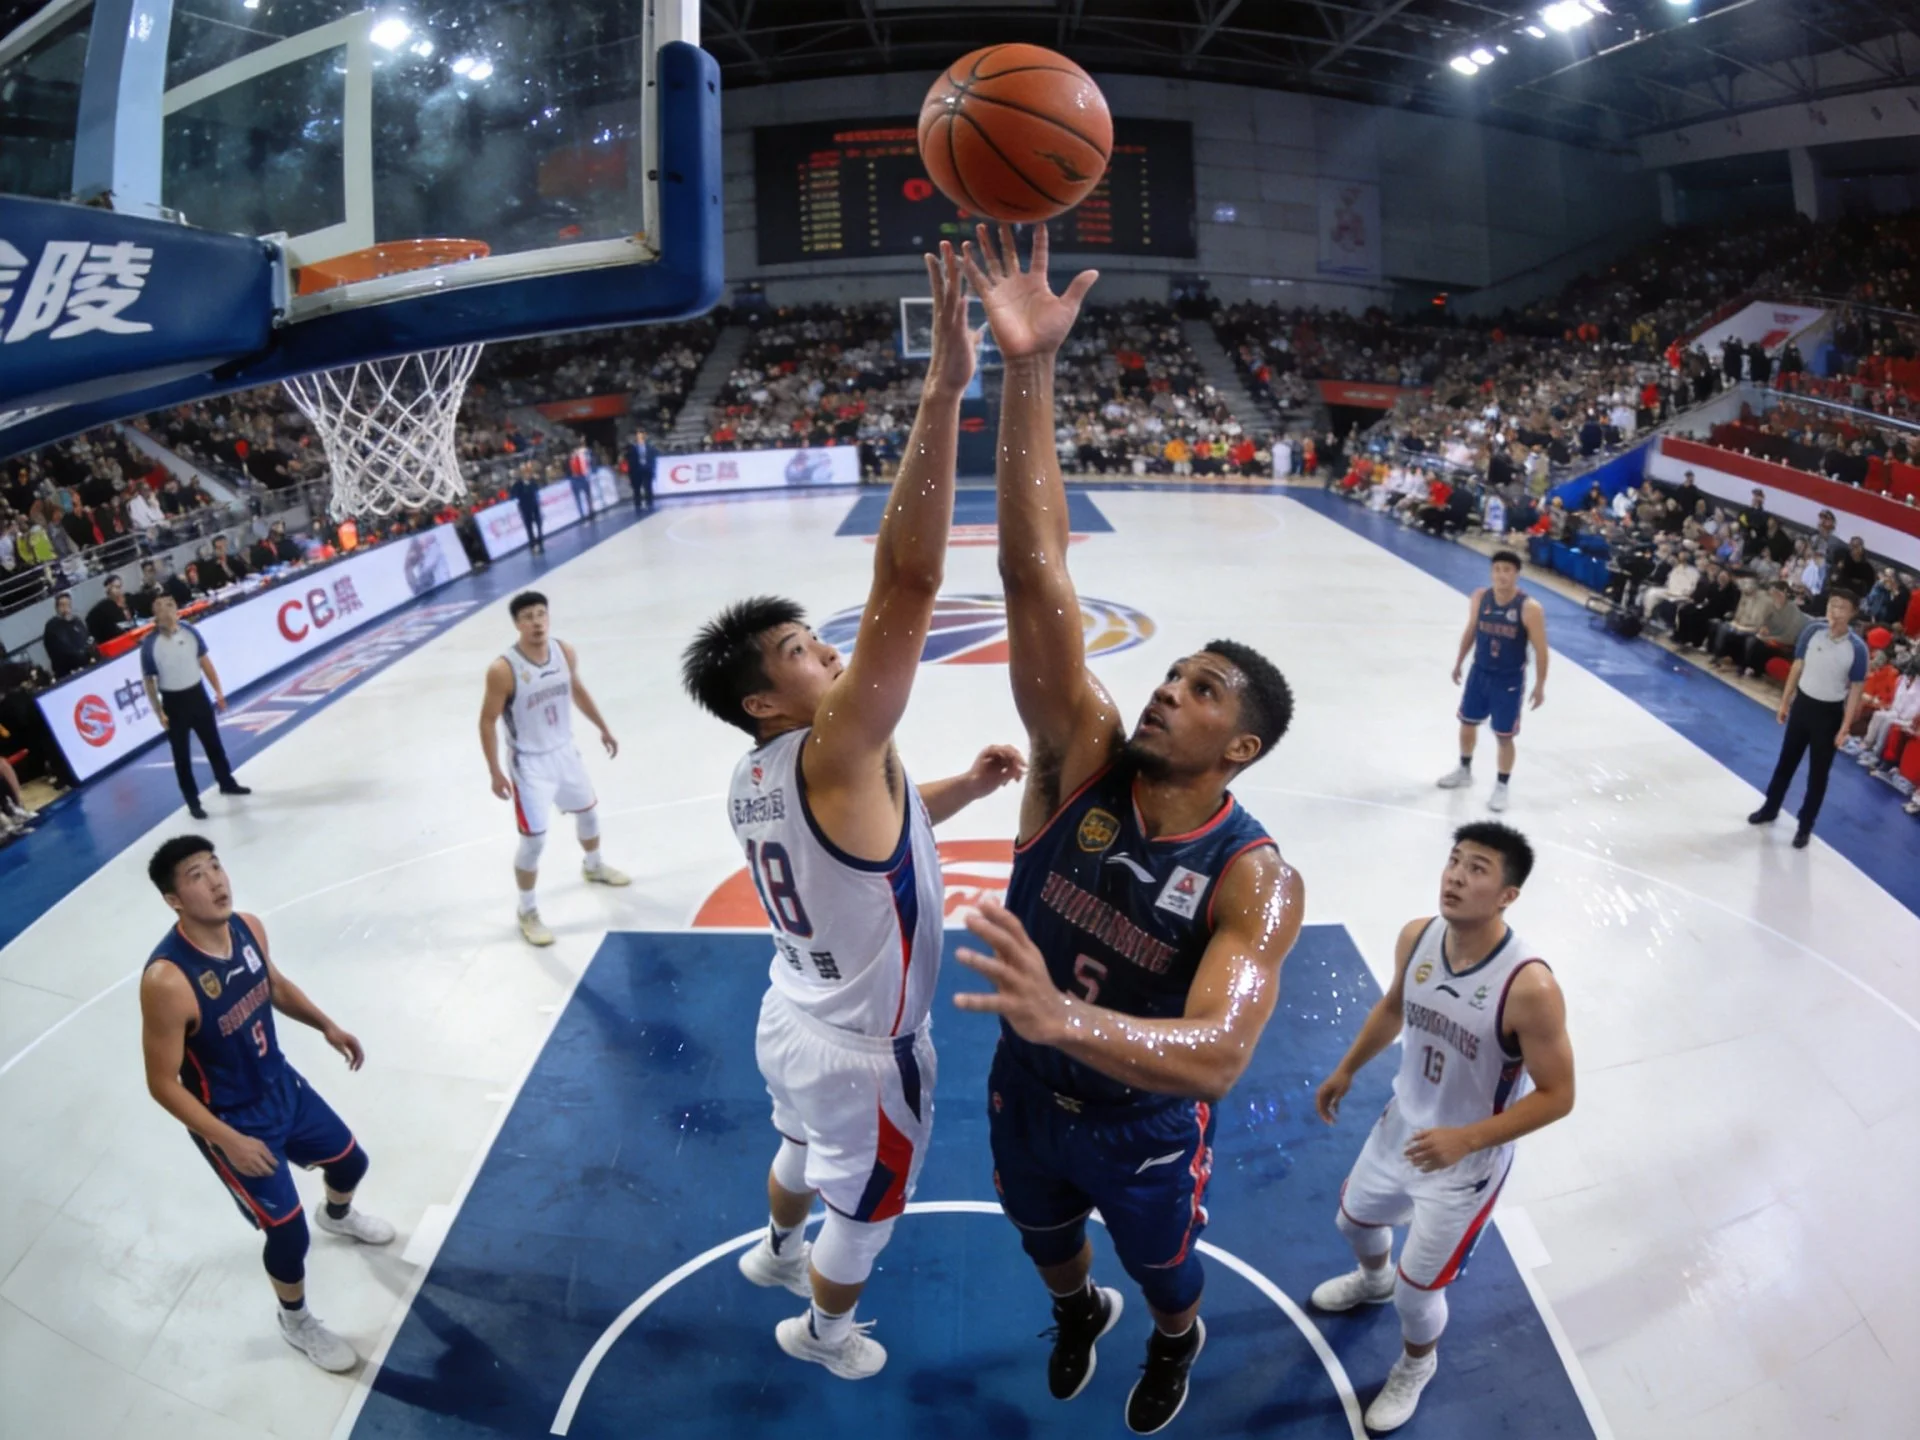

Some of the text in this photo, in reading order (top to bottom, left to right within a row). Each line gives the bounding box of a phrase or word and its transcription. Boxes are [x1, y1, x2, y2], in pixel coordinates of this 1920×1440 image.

[746, 838, 813, 940] 18
[1073, 952, 1108, 1005] 5
[1423, 1045, 1446, 1085] 13
